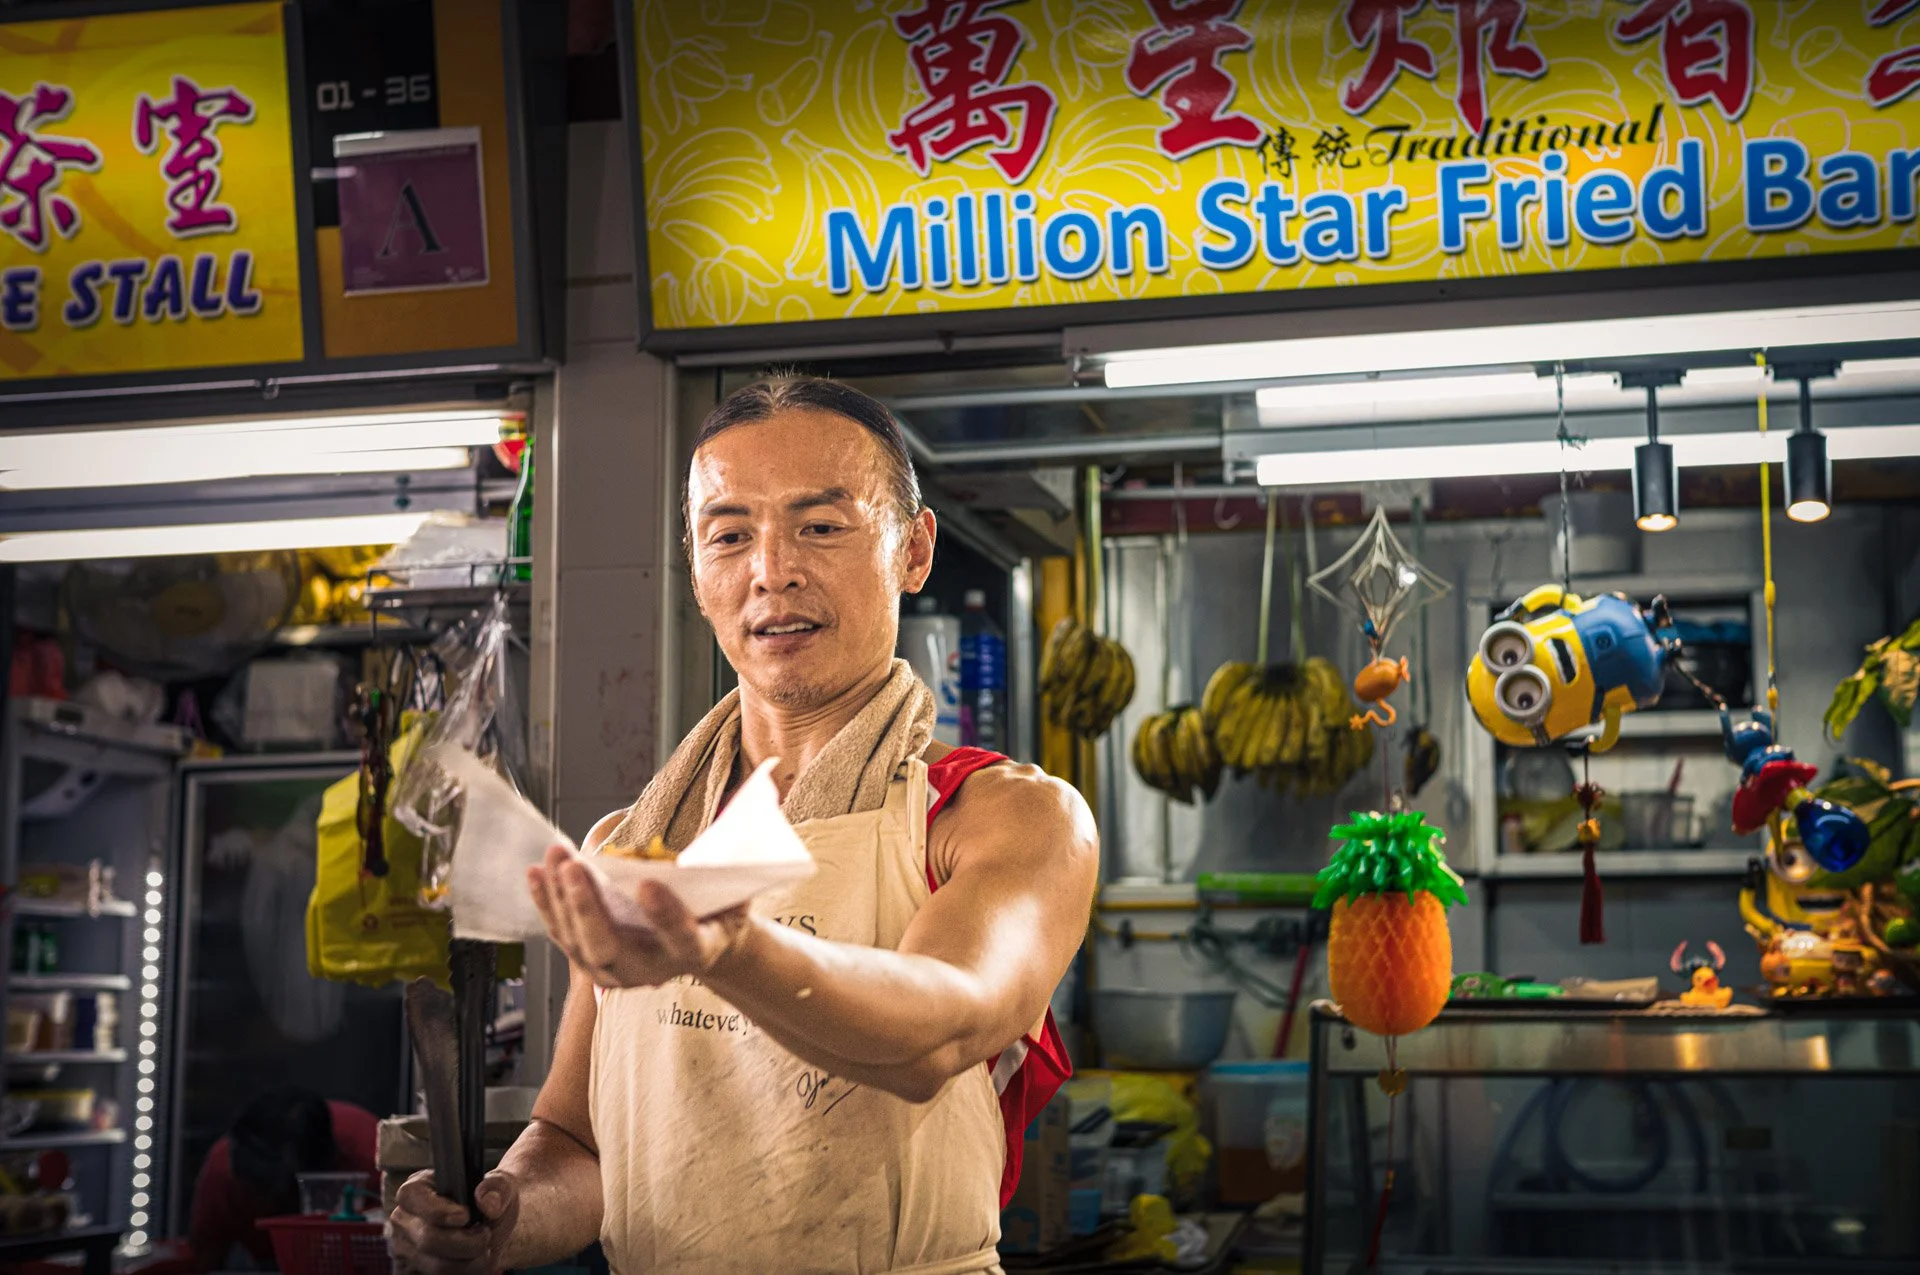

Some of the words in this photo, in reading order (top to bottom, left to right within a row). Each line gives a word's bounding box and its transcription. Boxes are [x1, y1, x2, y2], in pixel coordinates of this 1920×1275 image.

[1364, 103, 1665, 168] Traditional
[375, 177, 450, 260] A
[826, 192, 1168, 296] Million
[1197, 178, 1406, 271] Star
[1436, 136, 1709, 254] Fried
[63, 251, 262, 327] STALL
